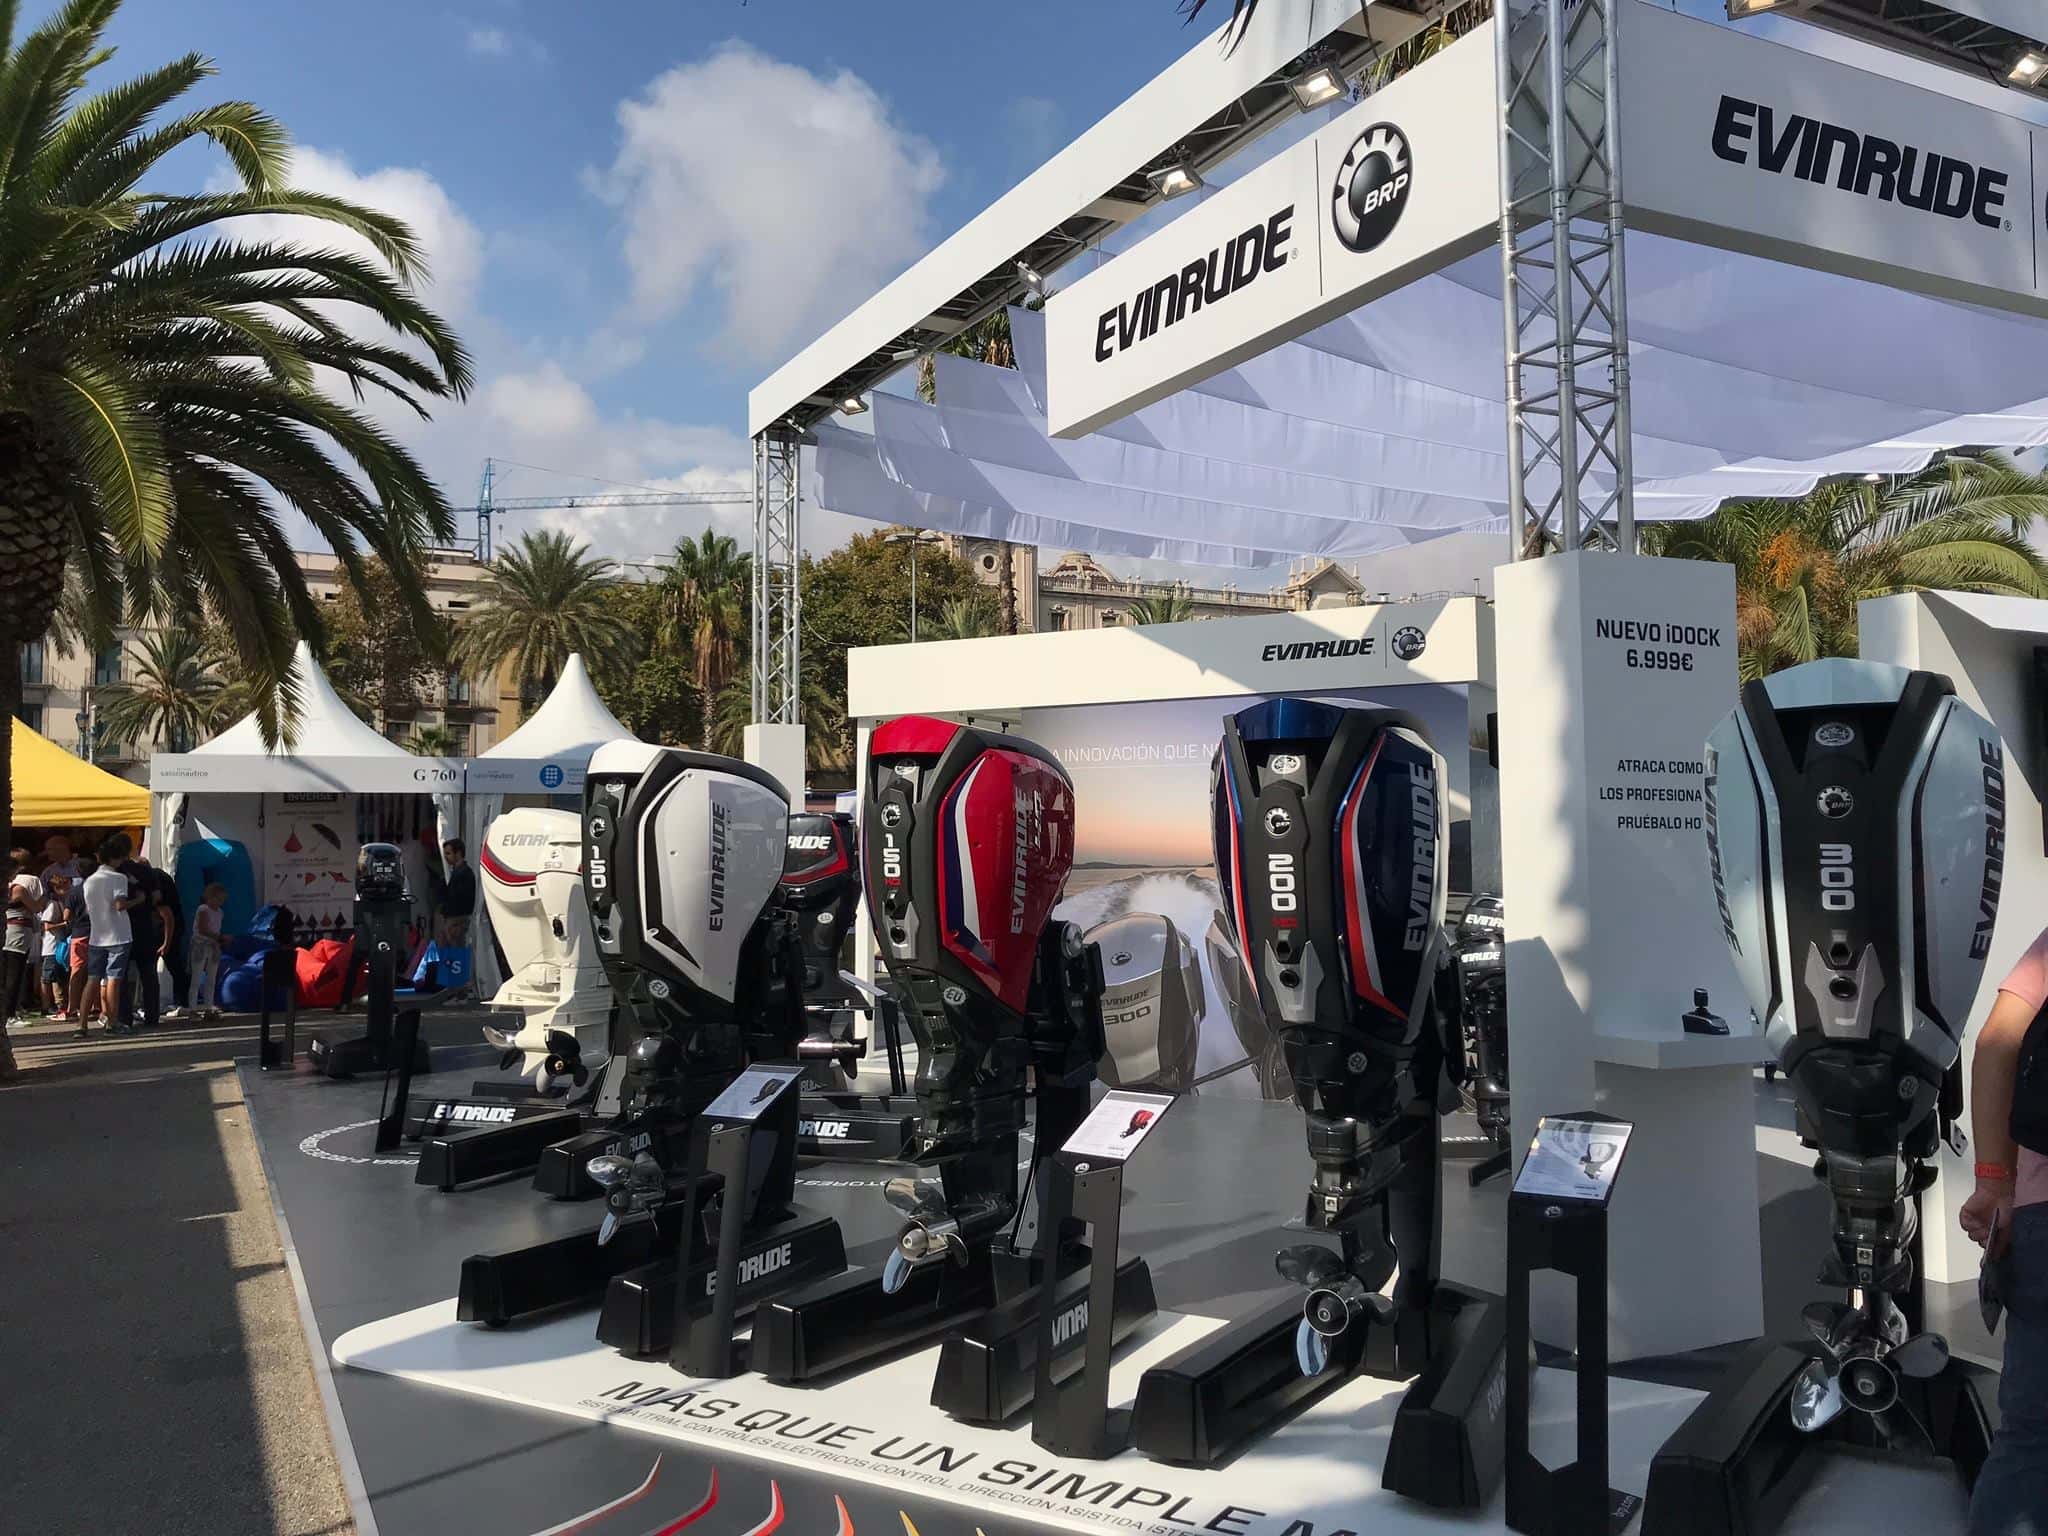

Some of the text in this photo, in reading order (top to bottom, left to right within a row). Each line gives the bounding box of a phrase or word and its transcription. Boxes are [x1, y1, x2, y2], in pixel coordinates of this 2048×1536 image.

[1711, 94, 2009, 229] EVINRUDE
[1361, 171, 1410, 216] BRP
[1094, 203, 1296, 363] EVINRUDE
[1261, 637, 1375, 662] EVINRUDE
[1596, 618, 1721, 648] NUEVO iDOCK
[1626, 648, 1694, 672] 6.999€
[413, 768, 426, 782] G
[431, 768, 457, 782] 760
[1064, 742, 1161, 763] INNOVACIÓN
[1164, 743, 1199, 762] QUE
[1617, 759, 1704, 775] ATRACA COMO
[1600, 786, 1623, 801] LOS
[1617, 813, 1682, 830] PRUÉBALO
[589, 844, 607, 889] 150
[709, 801, 726, 932] EVINRUDE
[883, 832, 902, 879] 150
[1011, 786, 1028, 935] EVINRUDE
[1403, 761, 1435, 952] EVINRUDE
[1968, 736, 2005, 961] EVINRUDE
[1268, 853, 1298, 912] 200
[1819, 843, 1856, 912] 300
[1103, 1005, 1152, 1026] 300
[433, 1103, 517, 1123] EVINRUDE
[598, 1380, 741, 1420] MÁS
[734, 1408, 876, 1450] QUE
[870, 1435, 980, 1473] UN
[977, 1459, 1268, 1536] SIMPLE
[683, 1420, 775, 1447] CONTROLES
[773, 1441, 871, 1469] ELECTRICOS
[958, 1482, 1057, 1510] DIRECCION
[1056, 1505, 1145, 1531] ASISTIDA
